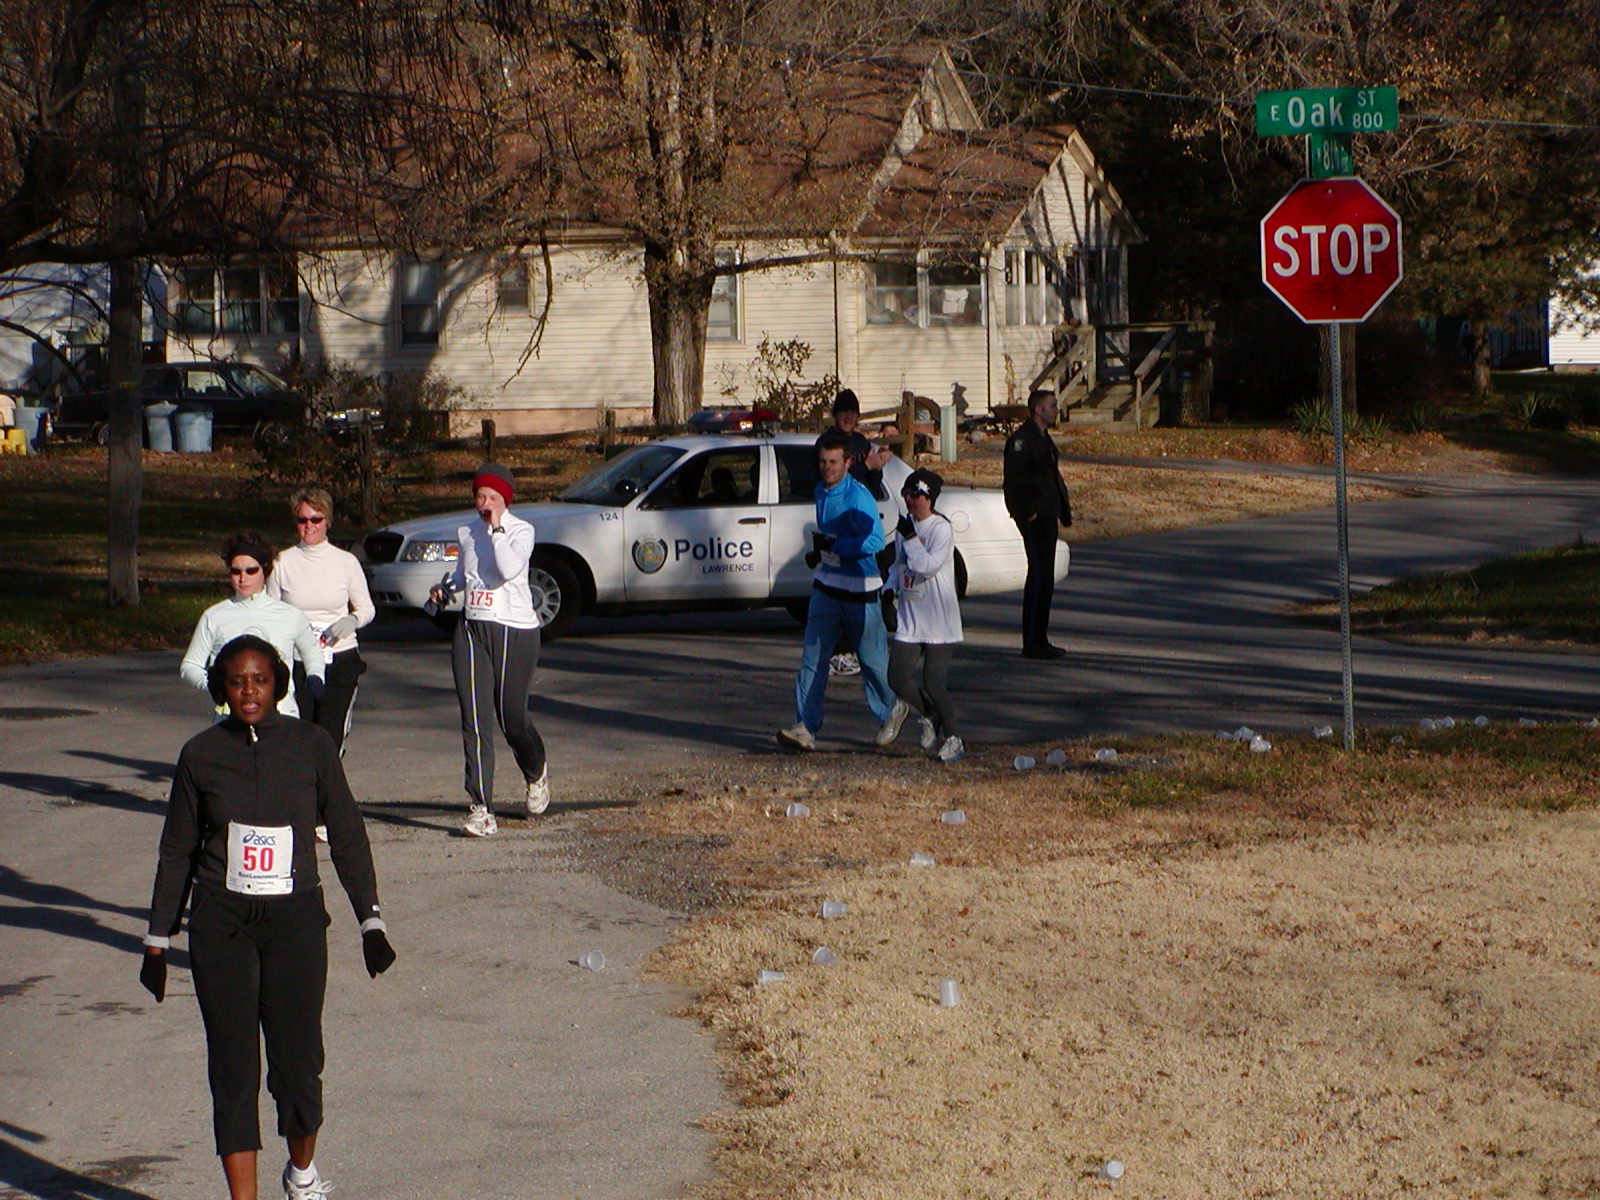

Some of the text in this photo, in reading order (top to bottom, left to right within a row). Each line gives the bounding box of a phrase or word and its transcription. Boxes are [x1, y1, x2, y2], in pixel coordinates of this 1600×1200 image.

[1270, 90, 1376, 128] E Oak ST
[1352, 111, 1384, 129] 800
[1272, 223, 1391, 277] STOP
[600, 512, 619, 521] 124
[674, 537, 754, 561] Police
[702, 563, 755, 575] LAWRENCE
[470, 590, 494, 607] 175
[243, 846, 275, 872] 50
